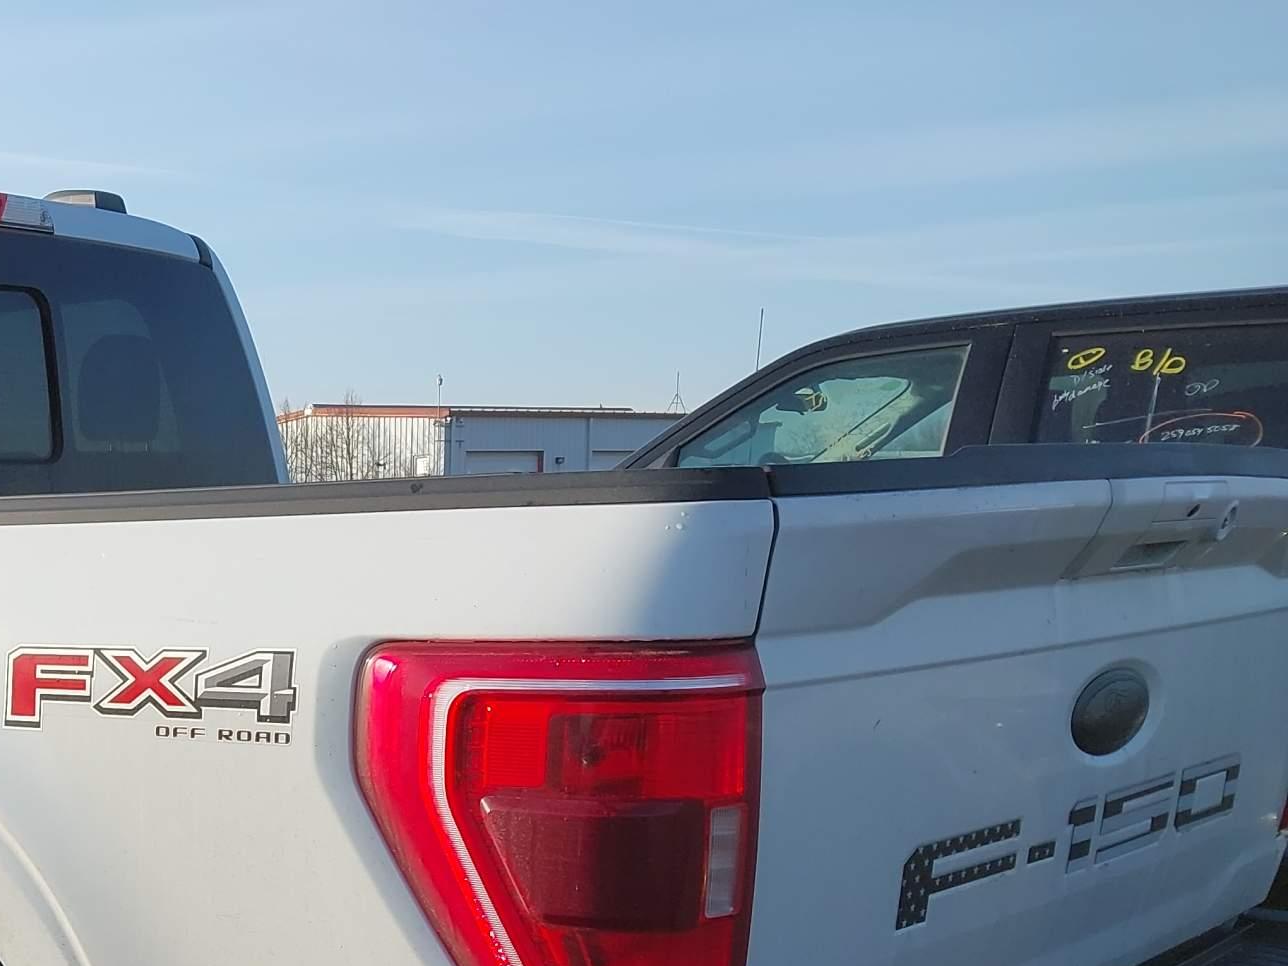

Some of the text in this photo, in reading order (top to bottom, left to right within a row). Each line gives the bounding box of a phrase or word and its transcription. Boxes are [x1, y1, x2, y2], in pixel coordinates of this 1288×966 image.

[3, 645, 299, 730] FX4
[155, 725, 291, 745] OFF ROAD
[895, 752, 1241, 931] F-150
